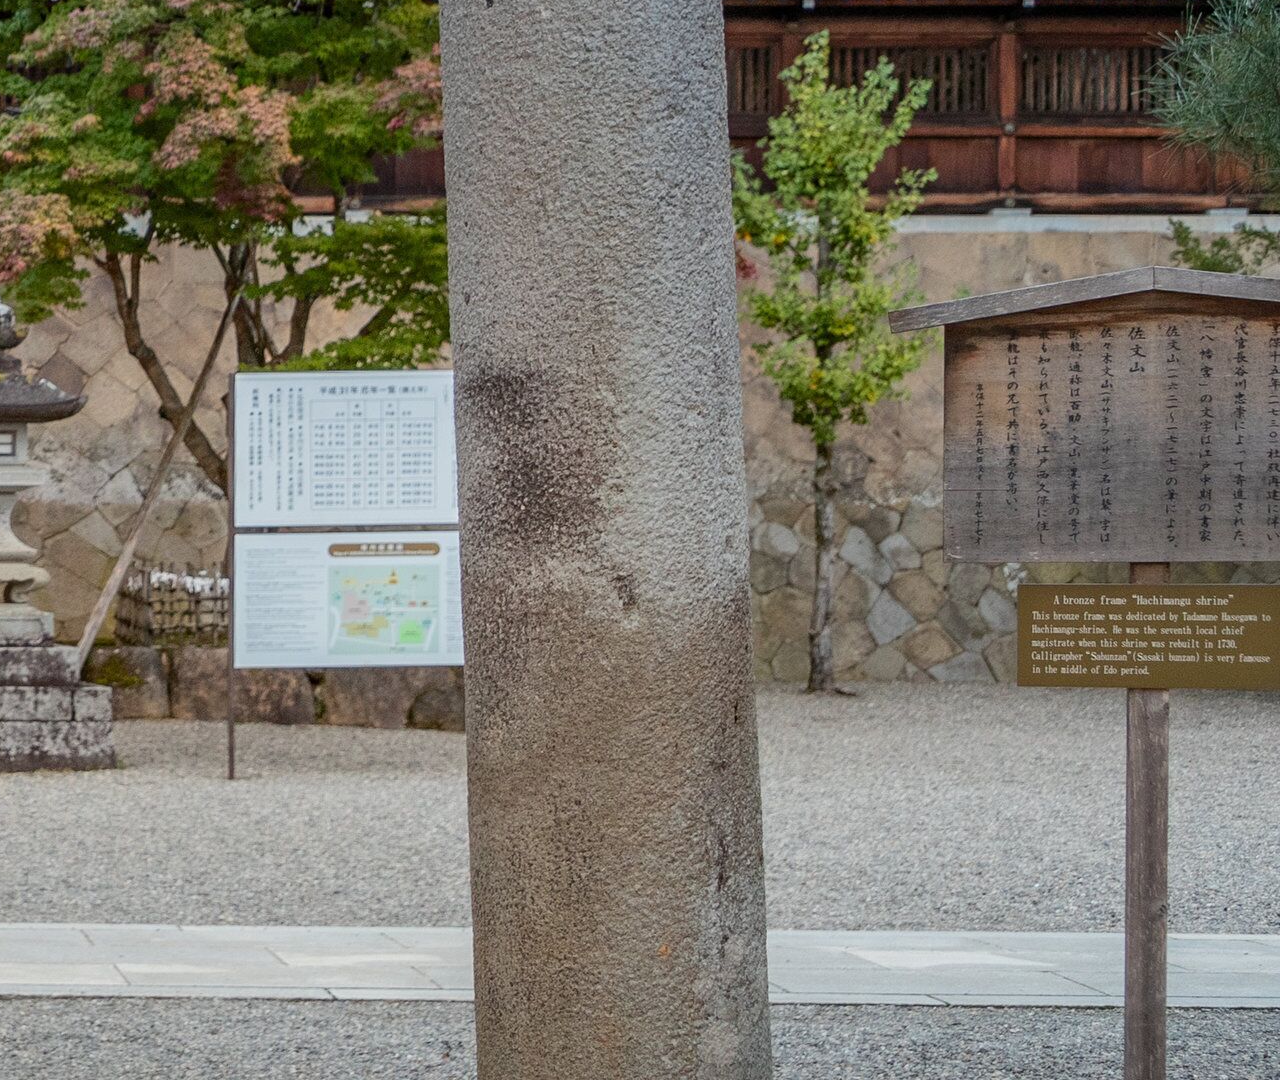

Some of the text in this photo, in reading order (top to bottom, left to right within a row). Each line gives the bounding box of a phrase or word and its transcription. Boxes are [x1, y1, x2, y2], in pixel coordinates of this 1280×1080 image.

[1128, 326, 1146, 374] 佐文山
[1053, 595, 1060, 605] A
[1063, 595, 1095, 605] bronze
[1100, 595, 1127, 605] frame
[1032, 611, 1050, 621] This
[1053, 611, 1080, 621] bronze
[1083, 612, 1105, 621] frame
[1109, 613, 1123, 621] was
[1126, 612, 1166, 621] dedicated
[1169, 612, 1179, 622] by
[1262, 614, 1272, 622] to
[1112, 626, 1122, 634] He
[1126, 627, 1139, 635] was
[1143, 626, 1157, 635] the
[1160, 626, 1191, 635] seventh
[1196, 626, 1217, 635] local
[1221, 626, 1245, 636] chief
[1031, 638, 1075, 649] magistrate
[1078, 639, 1097, 648] when
[1100, 639, 1118, 648] this
[1121, 639, 1148, 648] shrine
[1169, 639, 1199, 649] rebuilt
[1204, 640, 1214, 649] in
[1031, 651, 1083, 663] Calligrapher
[1204, 653, 1214, 663] is
[1217, 655, 1235, 664] very
[1239, 653, 1271, 663] famouse
[1032, 665, 1150, 676] in the middle of Edo period.
